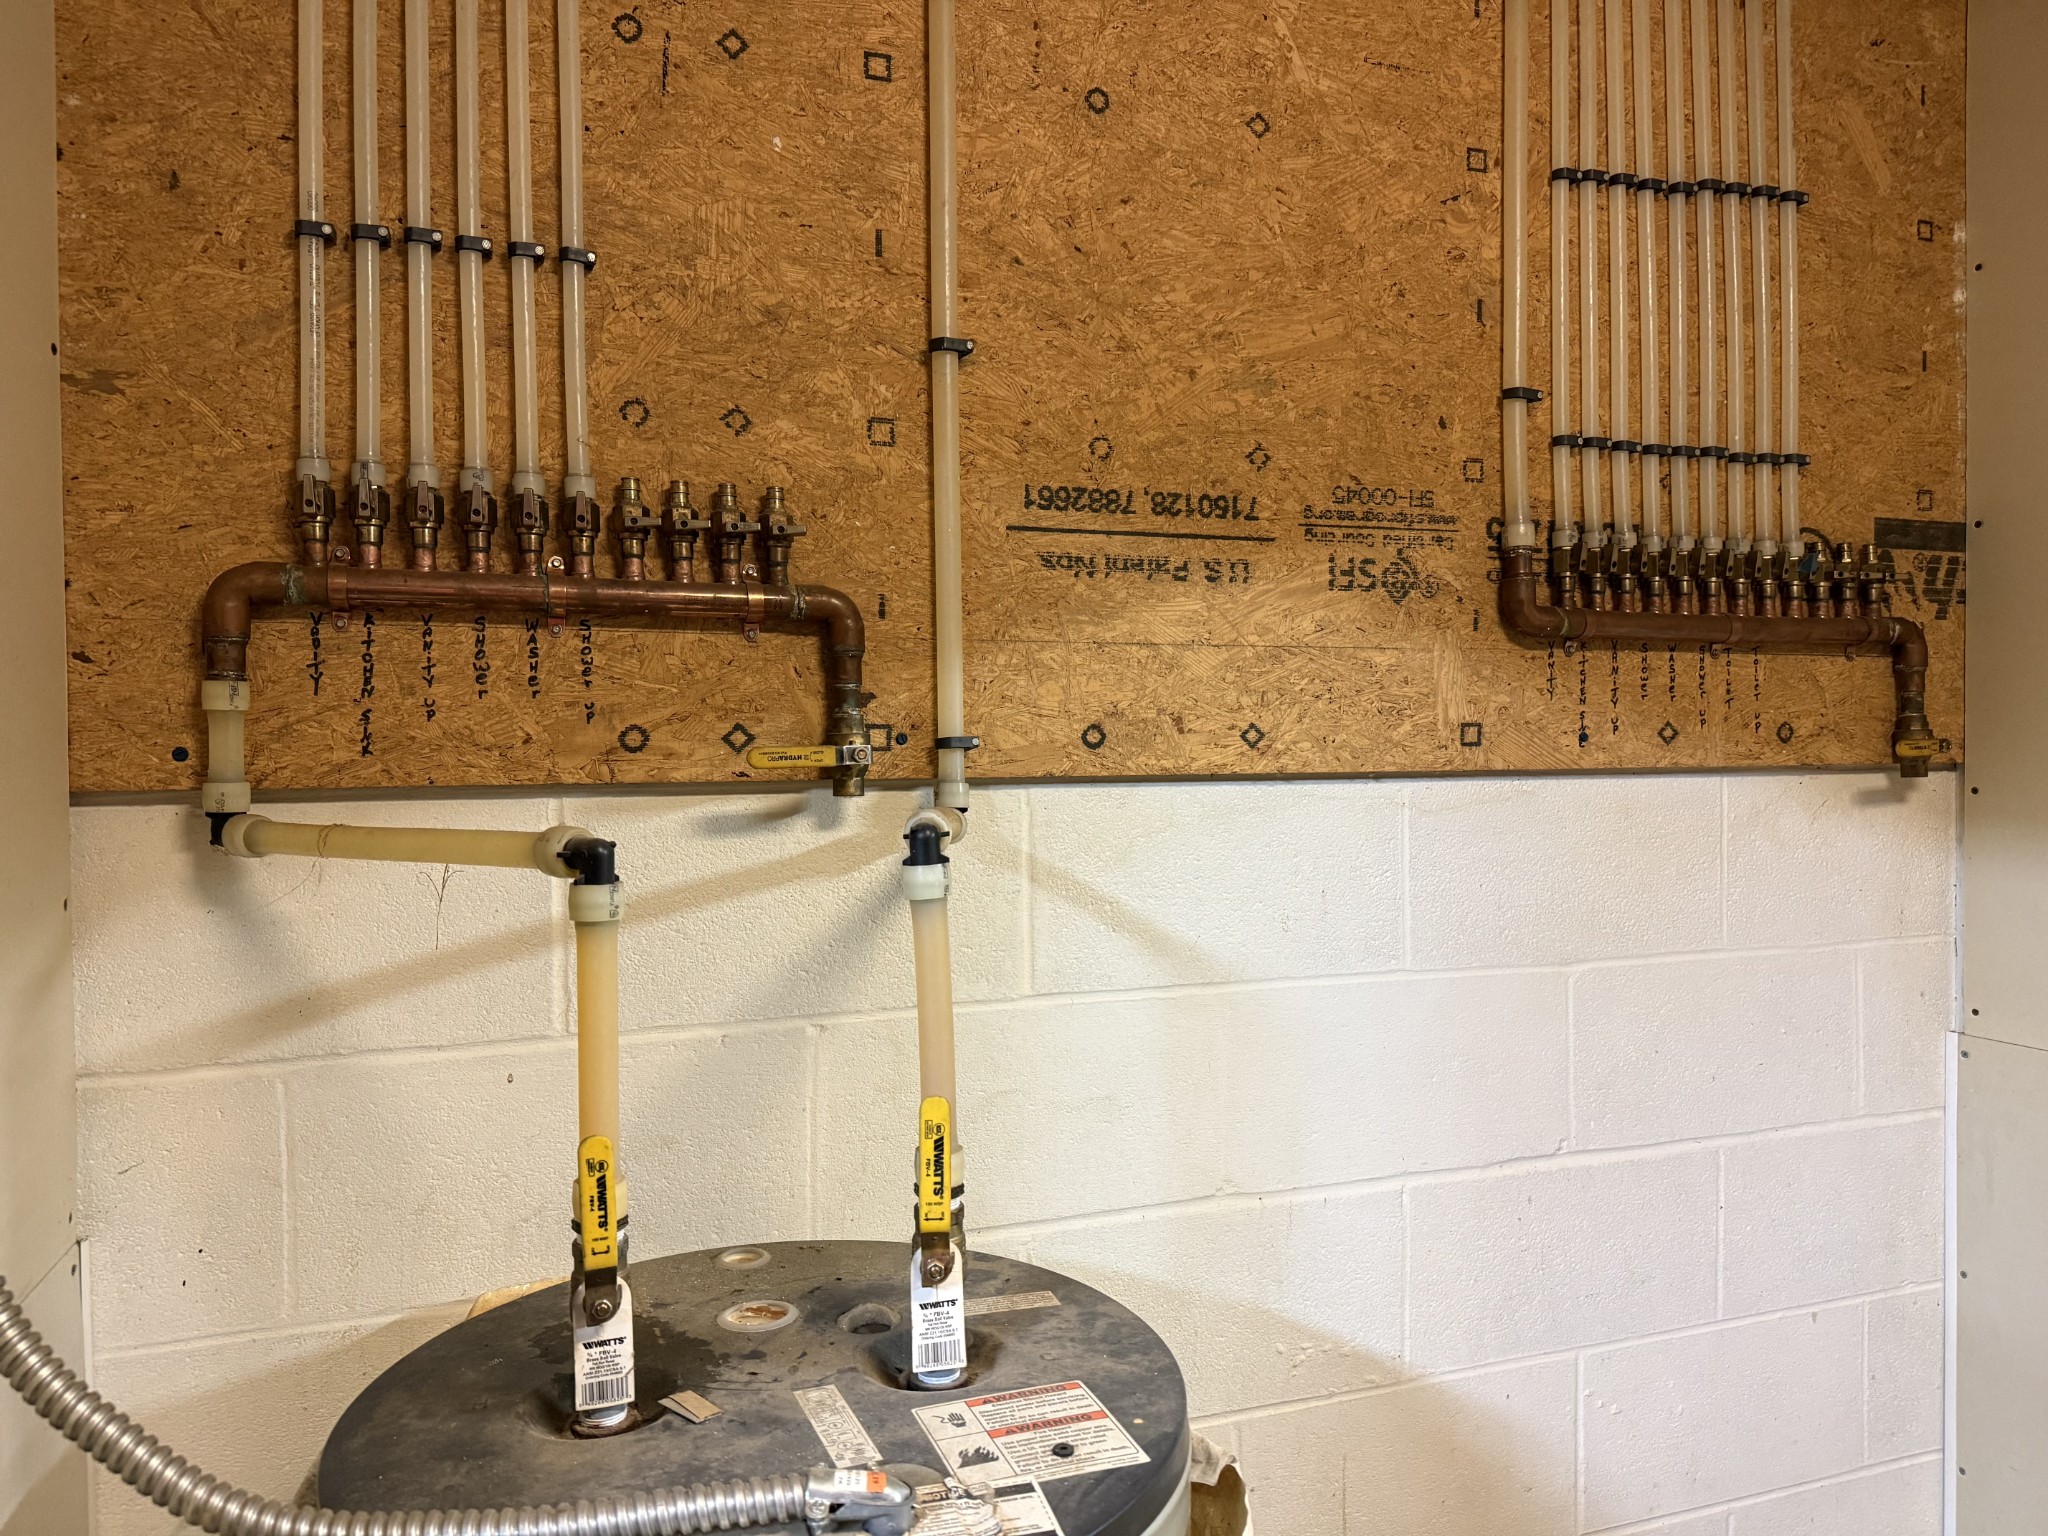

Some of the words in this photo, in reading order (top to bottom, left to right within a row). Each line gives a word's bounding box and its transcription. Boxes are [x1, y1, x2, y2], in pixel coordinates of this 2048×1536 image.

[1327, 553, 1377, 592] SFI
[933, 1136, 944, 1200] WATTS
[596, 1174, 608, 1232] WATTS
[919, 1299, 958, 1310] WATTS
[582, 1336, 627, 1350] WATTS
[991, 1384, 1067, 1402] WARNING
[1014, 1413, 1093, 1432] WARNING
